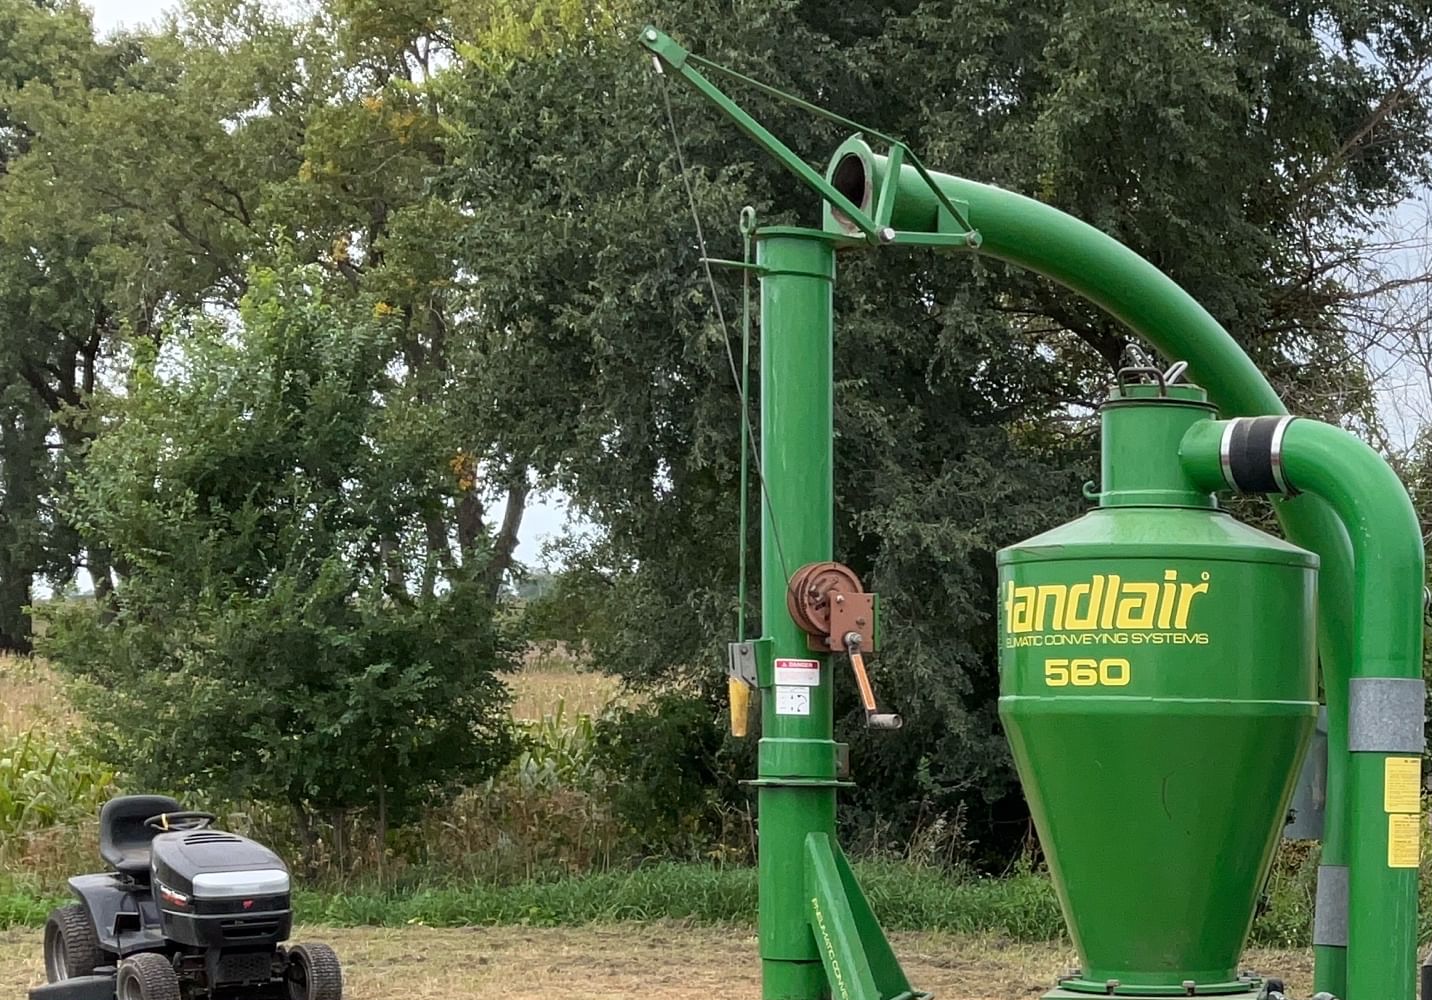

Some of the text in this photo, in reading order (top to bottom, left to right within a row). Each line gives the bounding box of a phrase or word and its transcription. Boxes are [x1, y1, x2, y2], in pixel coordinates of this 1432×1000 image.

[1006, 633, 1209, 649] EUMATIC CONVEYING SYSTEMS
[1044, 658, 1131, 687] 560
